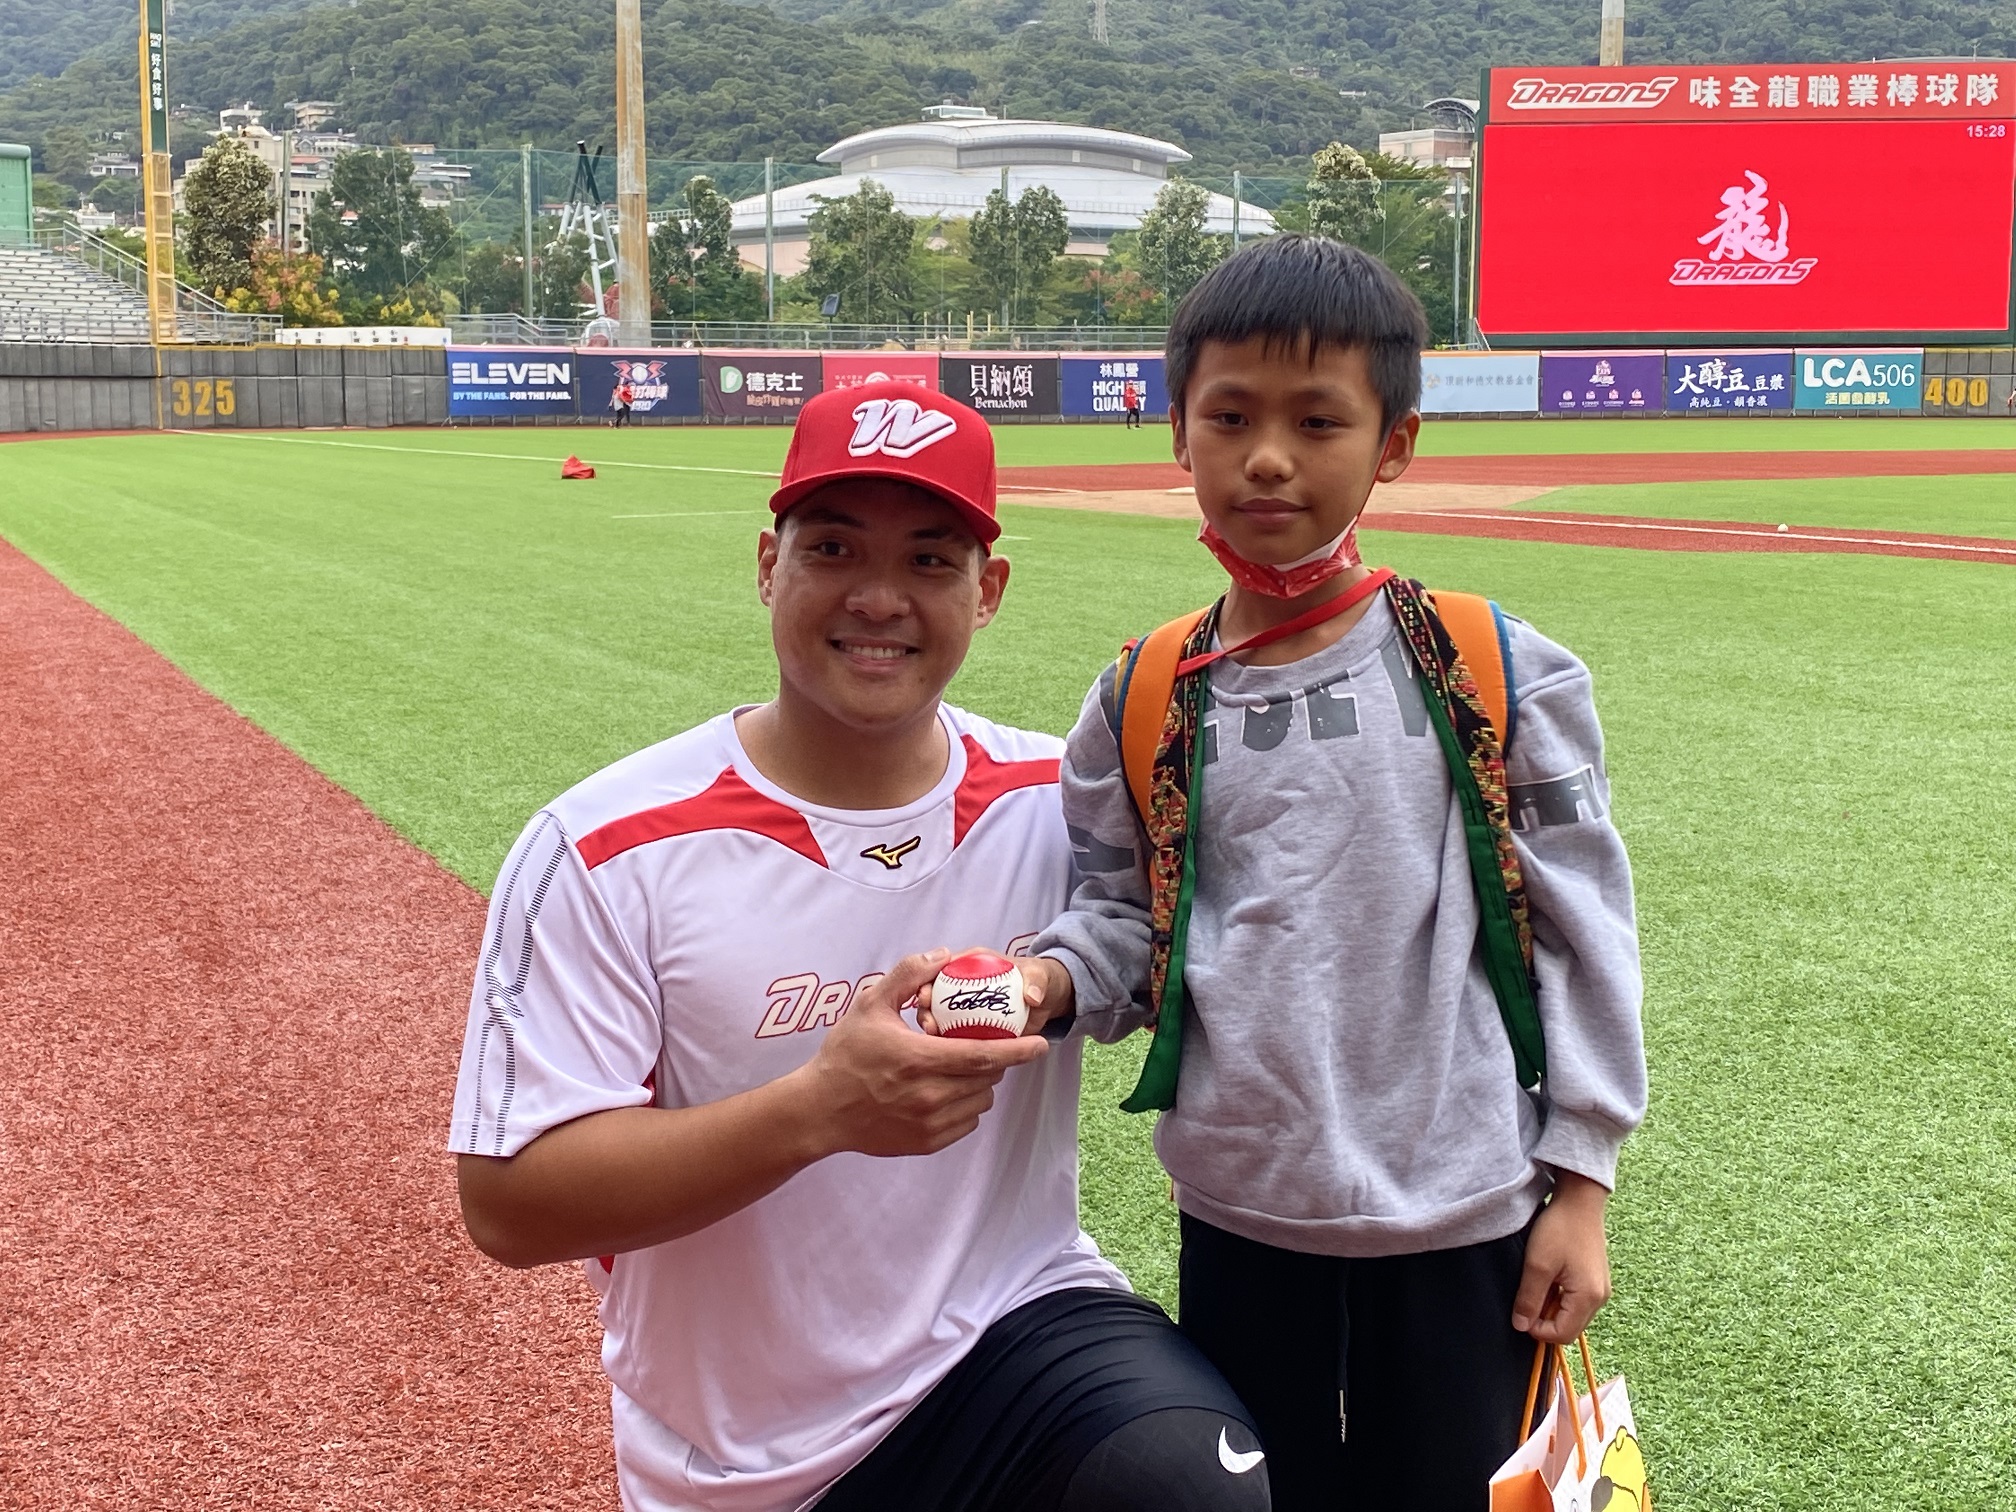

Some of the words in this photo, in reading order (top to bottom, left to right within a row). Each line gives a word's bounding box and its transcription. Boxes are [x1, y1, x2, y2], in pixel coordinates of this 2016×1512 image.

[151, 53, 162, 110] 好食好事
[1507, 76, 1680, 110] DRAGONS
[1688, 72, 2000, 110] 味全龍職業棒球隊
[1966, 124, 2006, 139] 15:28
[1669, 258, 1820, 286] DRAGONS
[452, 362, 570, 385] ELEVEN
[746, 372, 804, 392] 德克士
[970, 364, 1034, 397] 貝納頌
[1804, 358, 1915, 388] LCA506
[172, 379, 236, 417] 325
[453, 392, 464, 401] BY
[466, 392, 483, 401] THE
[484, 392, 509, 401] FANS.
[510, 392, 527, 401] FOR
[528, 392, 545, 401] THE
[546, 392, 572, 401] FANS.
[974, 396, 1028, 410] Bernachon
[1093, 396, 1146, 412] QUALY
[1925, 376, 1988, 407] 400
[848, 398, 958, 459] W
